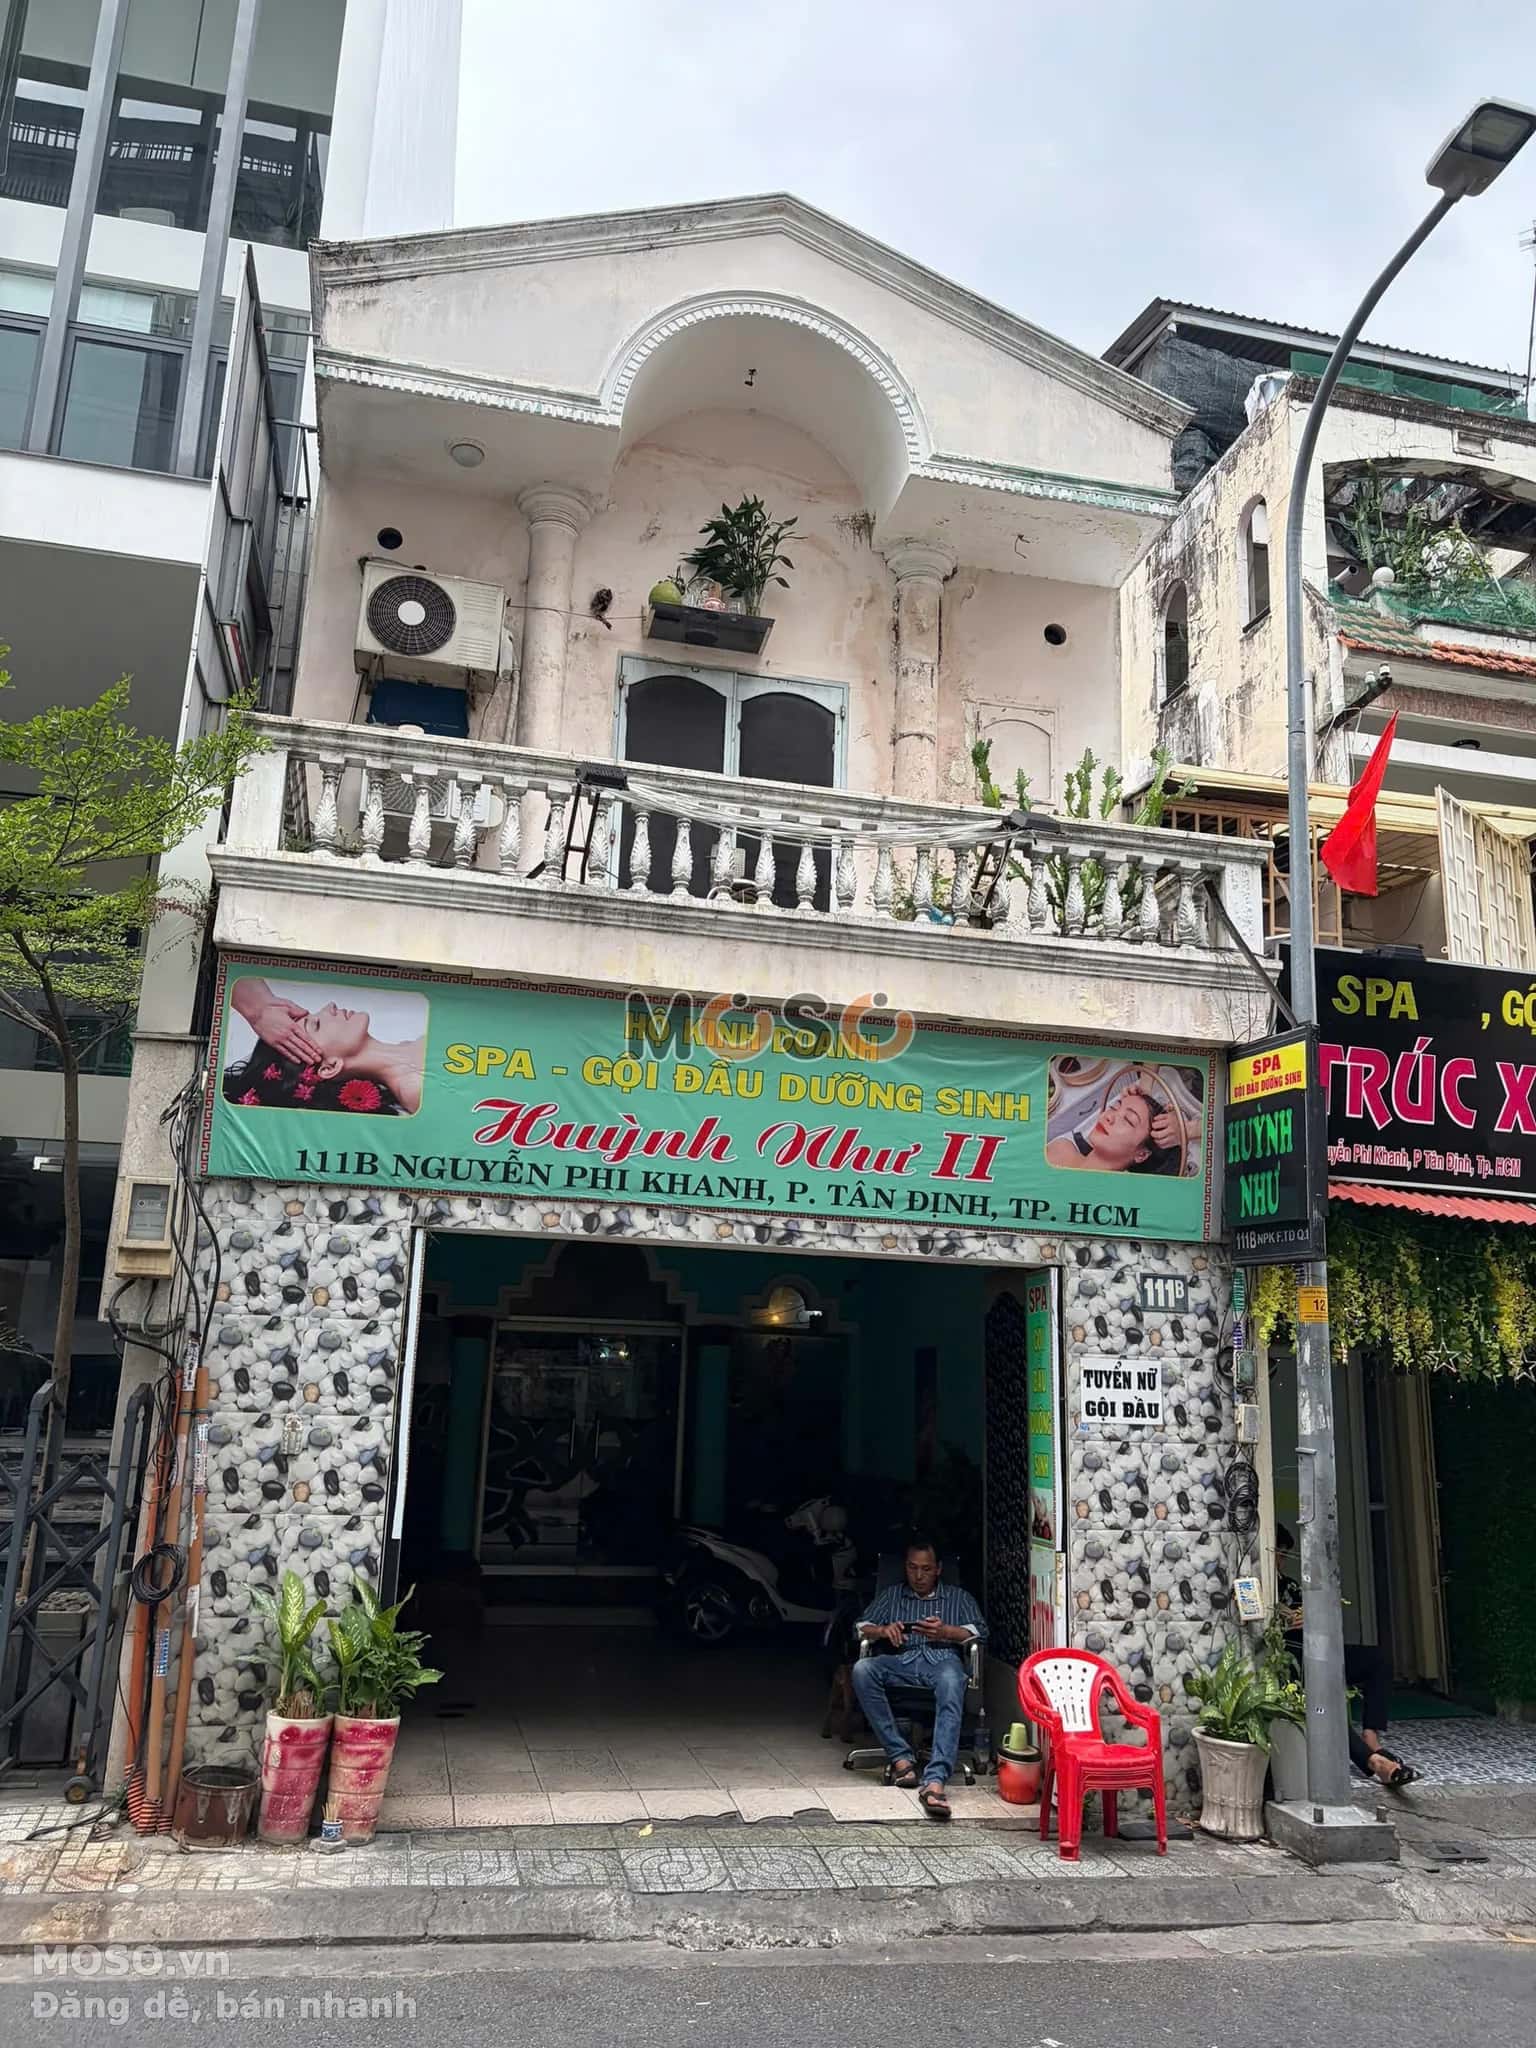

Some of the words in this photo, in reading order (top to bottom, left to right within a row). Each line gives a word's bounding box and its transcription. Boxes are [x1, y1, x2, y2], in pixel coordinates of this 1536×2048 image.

[1331, 974, 1420, 1021] SPA
[684, 1017, 762, 1051] KINH
[771, 1026, 880, 1062] DOANH
[1252, 1053, 1281, 1076] SPA
[442, 1042, 536, 1080] SPA
[581, 1052, 659, 1094] GỘI
[778, 1072, 923, 1113] DƯỠNG
[936, 1088, 1032, 1122] SINH
[1318, 1036, 1478, 1131] TRÚC
[472, 1098, 738, 1164] Huỳnh
[756, 1122, 922, 1178] Như
[930, 1132, 1008, 1184] II
[1353, 1144, 1372, 1163] Phi
[1373, 1145, 1411, 1171] Khanh,
[1413, 1150, 1423, 1168] P
[1495, 1157, 1521, 1177] HCM
[296, 1149, 380, 1178] 111B
[392, 1149, 552, 1187] NGUYỄN
[565, 1165, 630, 1194] PHI
[640, 1172, 775, 1207] KHANH,
[787, 1180, 817, 1204] P.
[827, 1179, 897, 1210] TÂN
[905, 1191, 1000, 1222] ĐỊNH,
[1008, 1198, 1058, 1223] TP.
[1068, 1203, 1140, 1229] HCM
[1257, 1231, 1276, 1245] NPK
[1029, 1286, 1048, 1312] SPA
[1144, 1278, 1185, 1308] 111B
[1313, 1298, 1326, 1312] 12
[1083, 1361, 1131, 1390] TUYỂN
[1085, 1396, 1116, 1422] GỘI
[1122, 1395, 1160, 1419] ĐẦU
